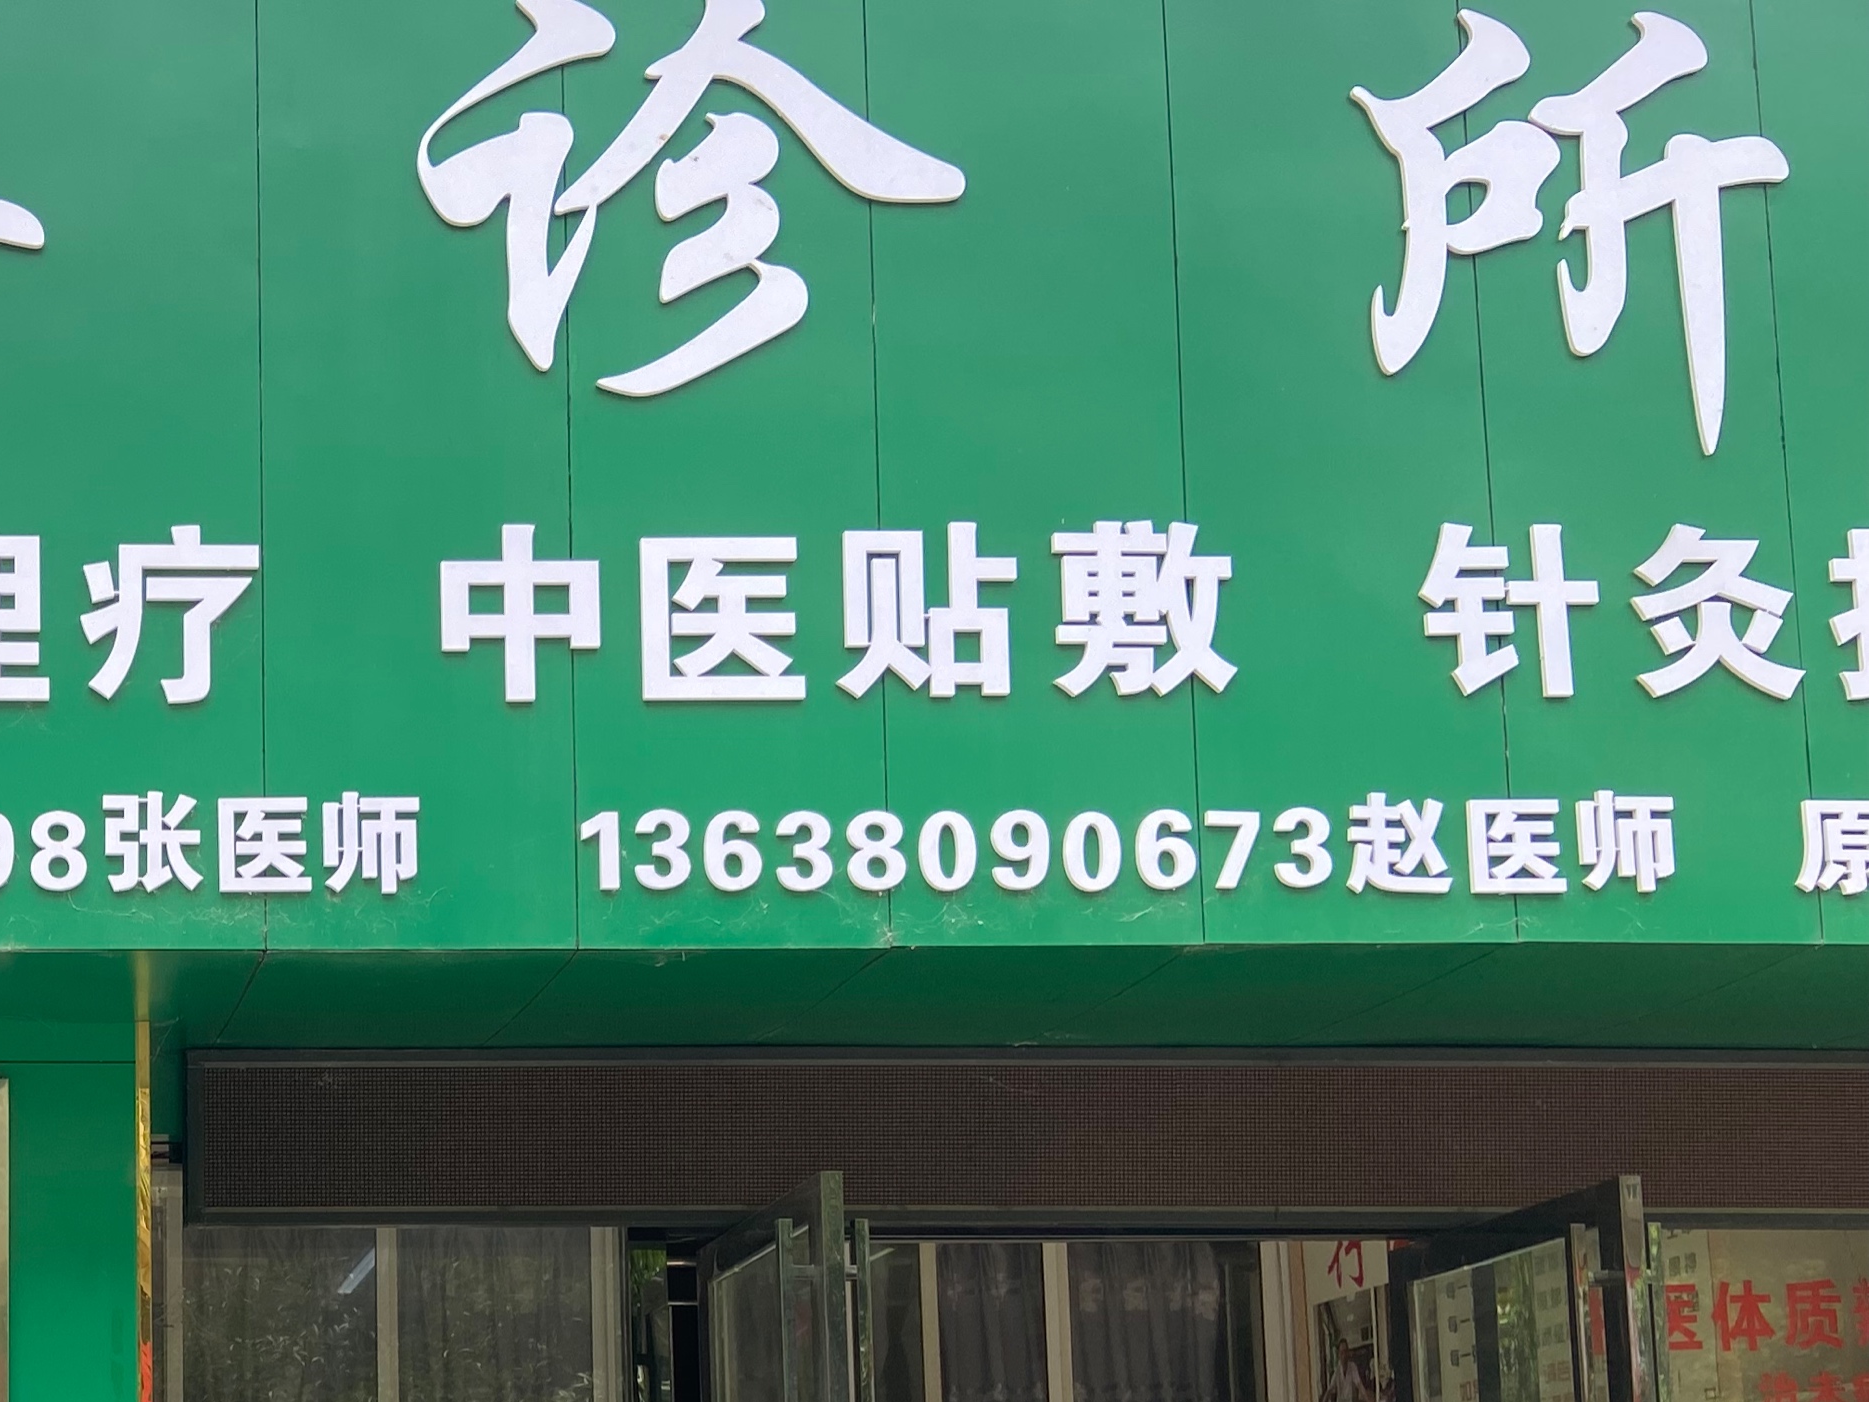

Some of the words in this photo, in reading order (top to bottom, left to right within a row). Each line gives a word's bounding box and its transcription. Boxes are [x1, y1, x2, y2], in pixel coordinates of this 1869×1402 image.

[440, 521, 1237, 703] 中医贴敷
[581, 790, 1674, 896] 13638090673赵医师
